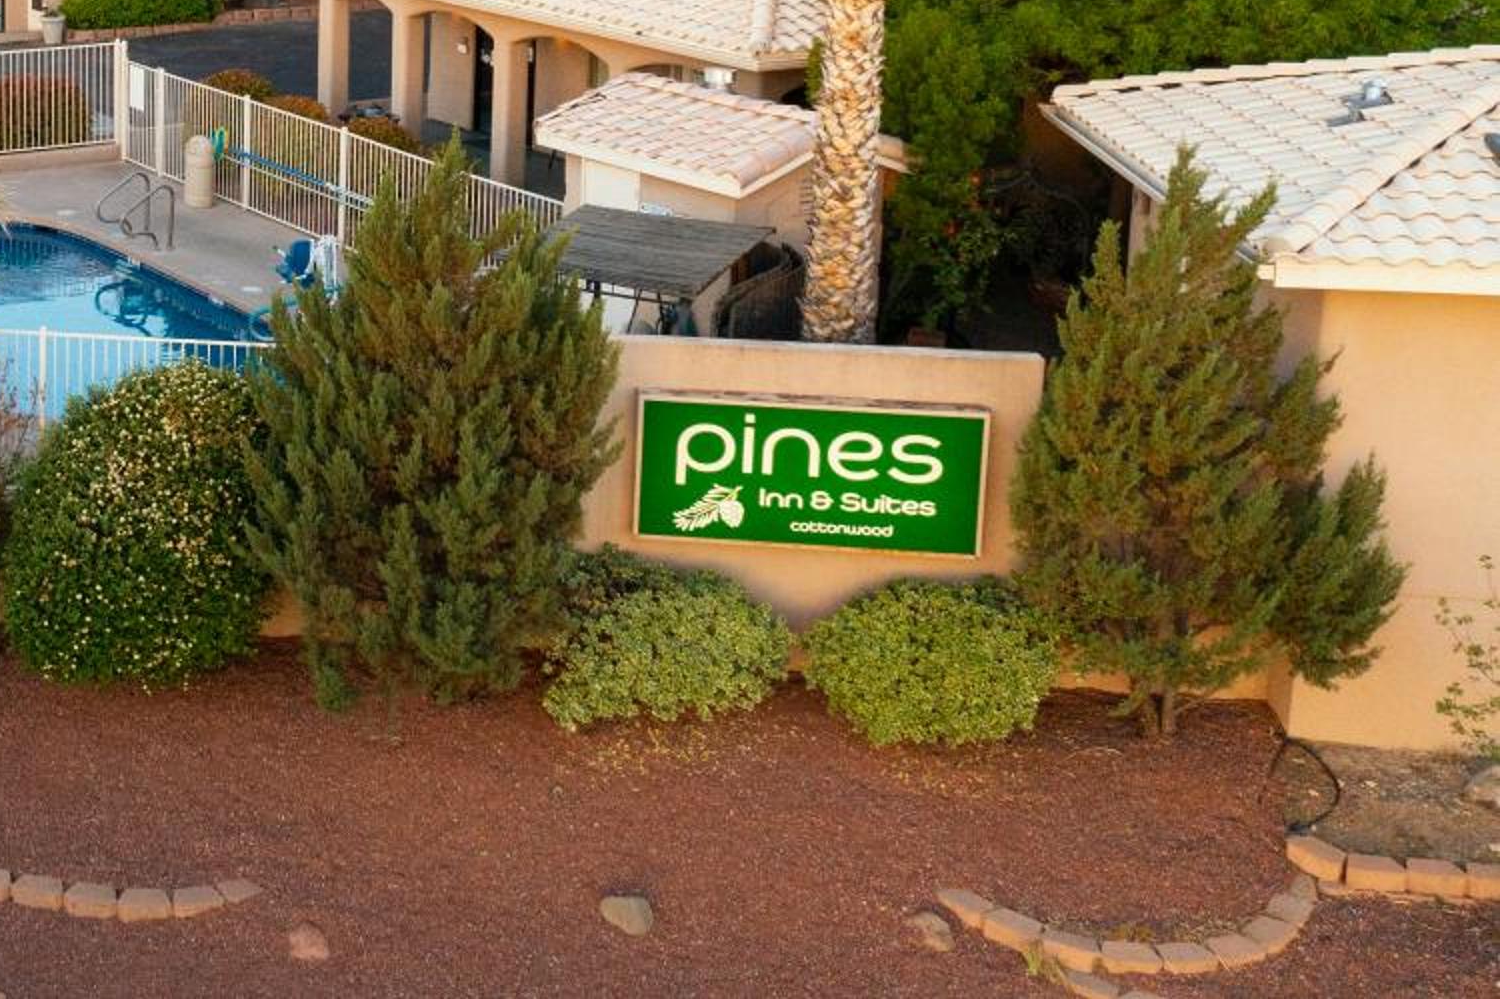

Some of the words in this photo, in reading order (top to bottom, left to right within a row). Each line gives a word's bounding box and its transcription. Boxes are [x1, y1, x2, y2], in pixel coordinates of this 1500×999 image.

[675, 412, 944, 485] pines
[758, 487, 804, 510] Inn
[810, 490, 834, 512] &
[839, 491, 937, 517] Suites
[789, 520, 894, 538] cottonwood
